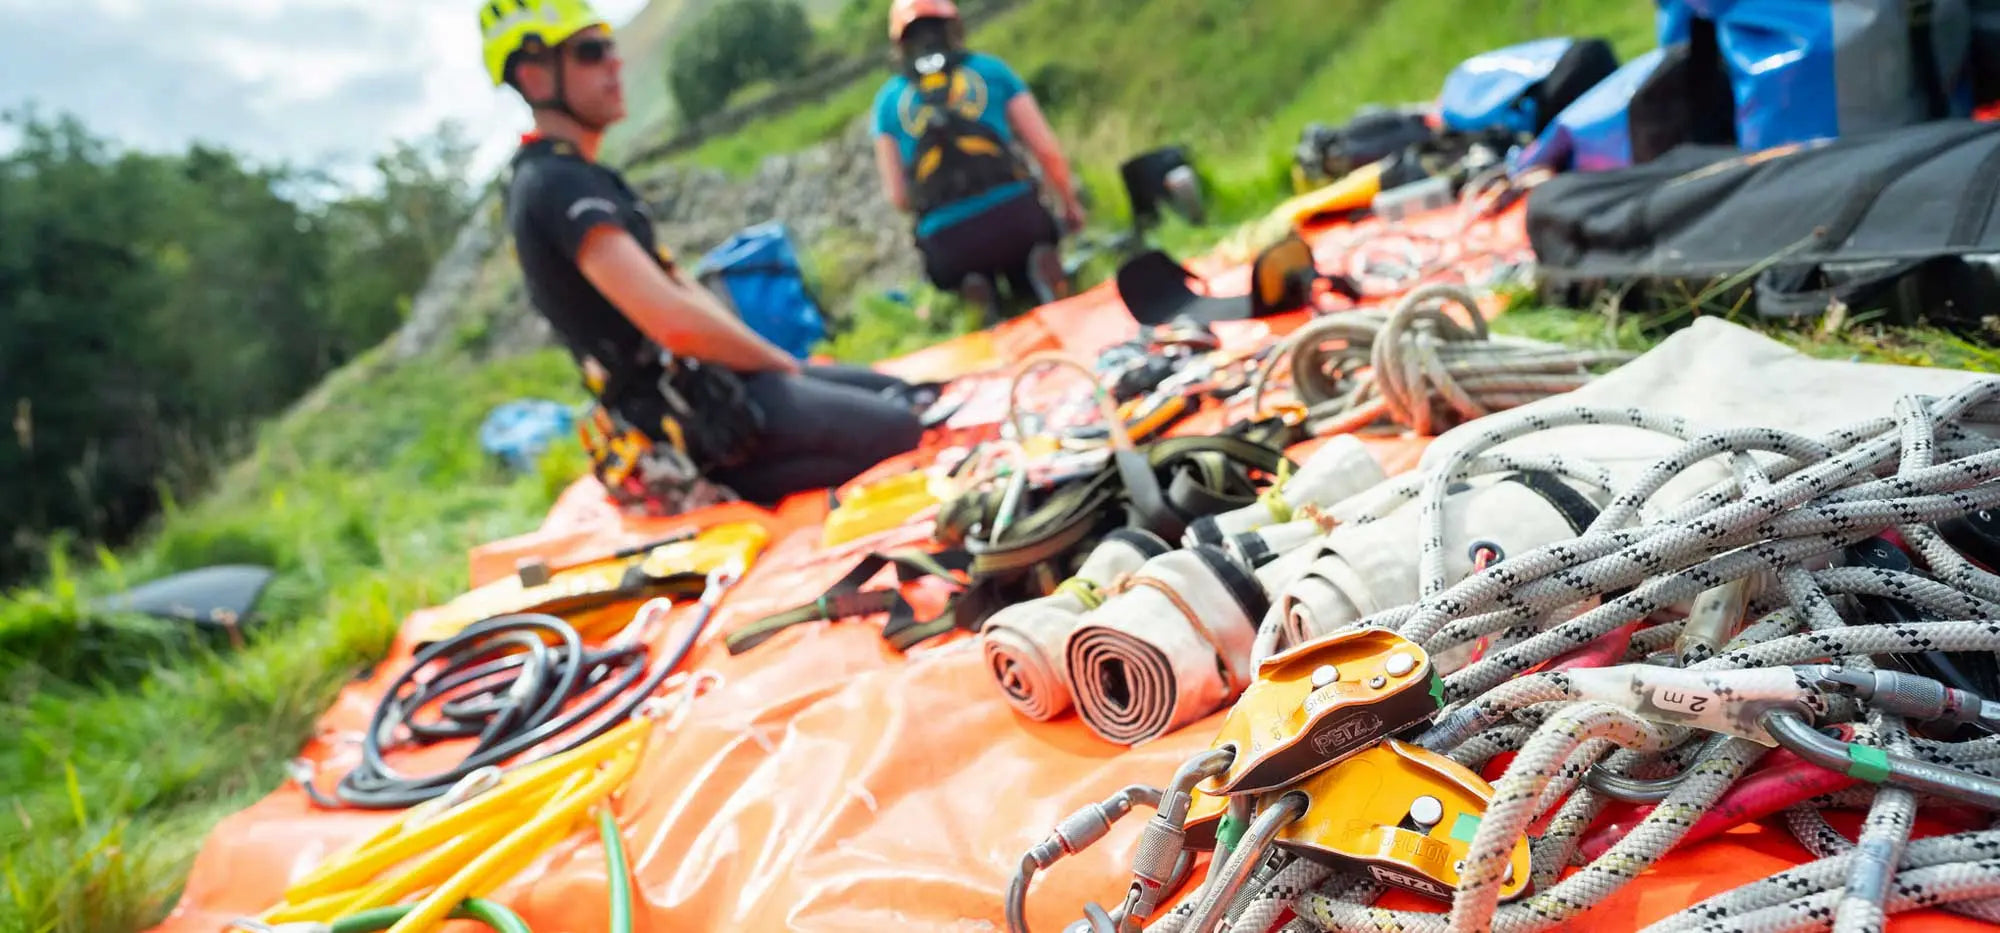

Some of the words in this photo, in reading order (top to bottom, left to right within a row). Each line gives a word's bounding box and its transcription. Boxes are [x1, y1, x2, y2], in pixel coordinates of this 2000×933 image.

[1663, 691, 1684, 704] m
[1689, 696, 1709, 712] 2
[1313, 716, 1384, 757] PETZL
[1368, 865, 1448, 897] PETZL
